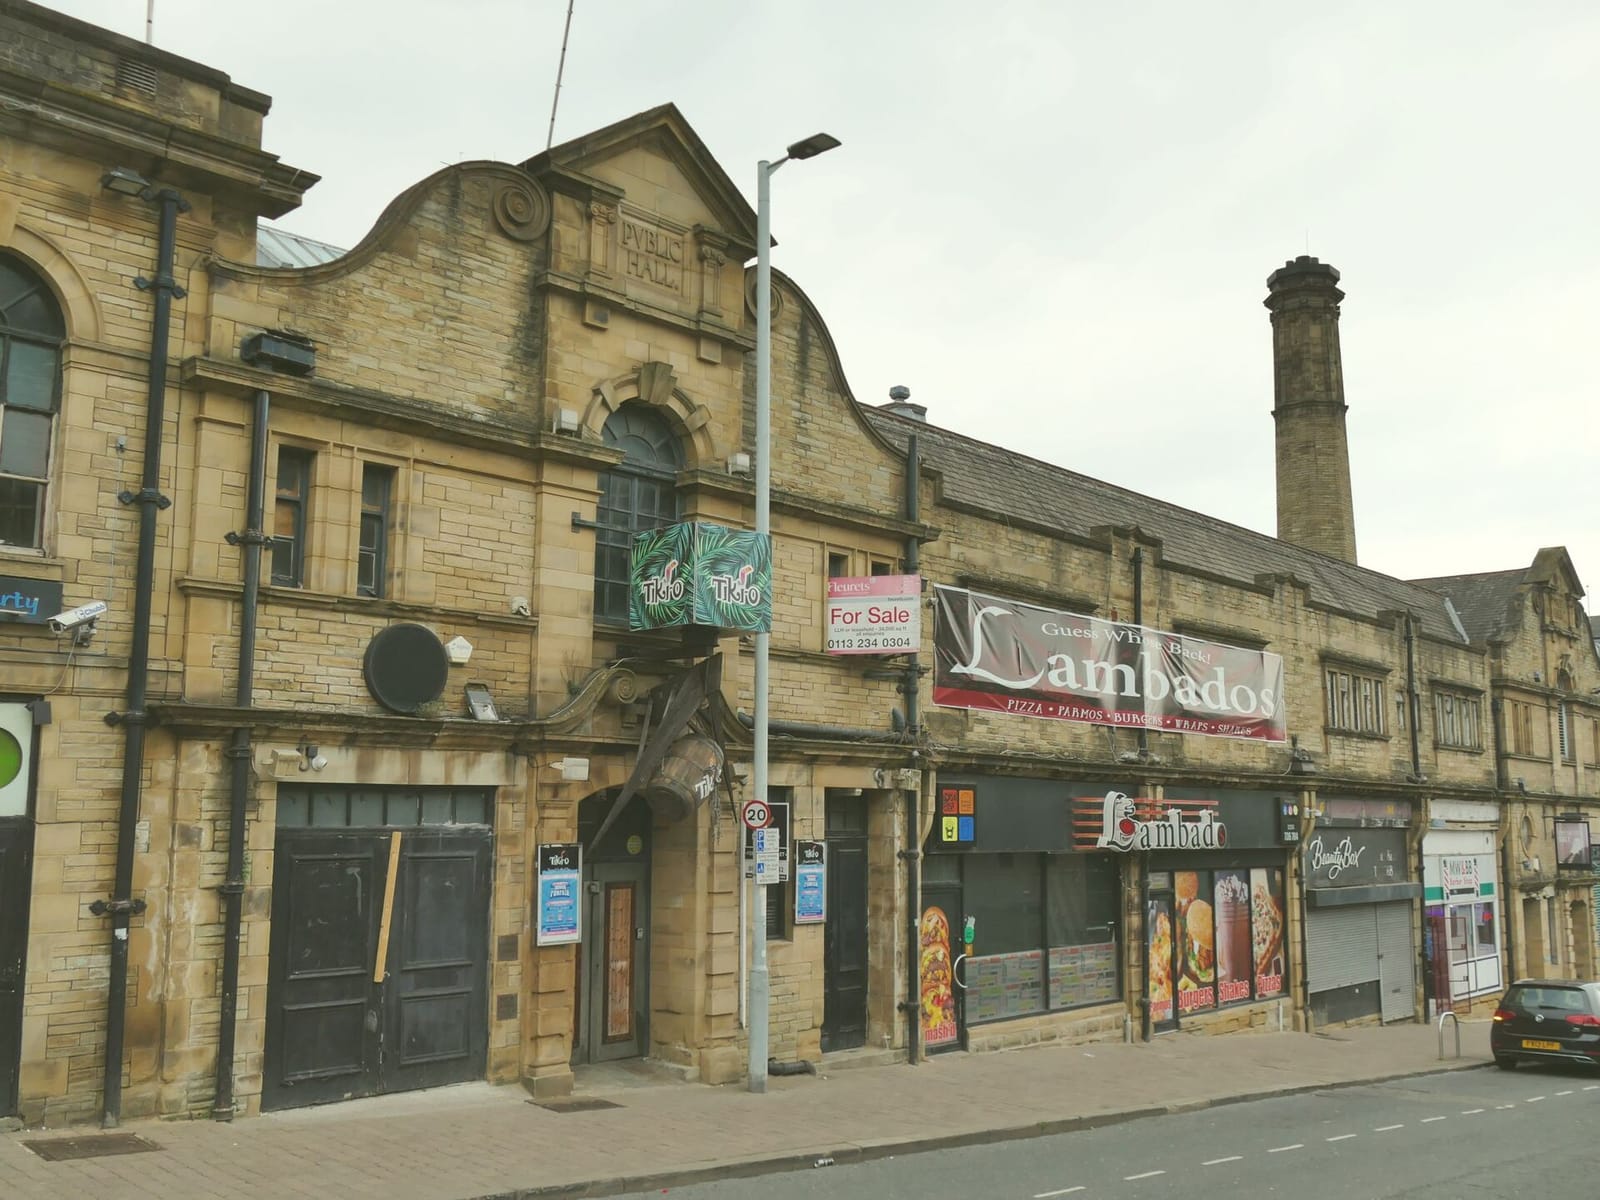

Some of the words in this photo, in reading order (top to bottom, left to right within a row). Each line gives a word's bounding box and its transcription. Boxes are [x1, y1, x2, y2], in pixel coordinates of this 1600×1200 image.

[0, 591, 39, 616] rty
[831, 608, 862, 624] For
[868, 606, 910, 624] Sale
[828, 639, 853, 648] 0113
[857, 638, 878, 648] 234
[882, 637, 910, 647] 0304
[1041, 622, 1098, 639] Guess
[1169, 642, 1211, 665] Back!
[951, 606, 1275, 718] Lambados
[1007, 699, 1043, 714] PIZZA
[1058, 705, 1103, 720] PARMOS
[1114, 712, 1163, 727] BURGERS
[1175, 718, 1208, 731] WRAPS
[747, 809, 766, 821] 20
[1178, 986, 1214, 1010] Burgers
[1219, 979, 1249, 1001] Shakes
